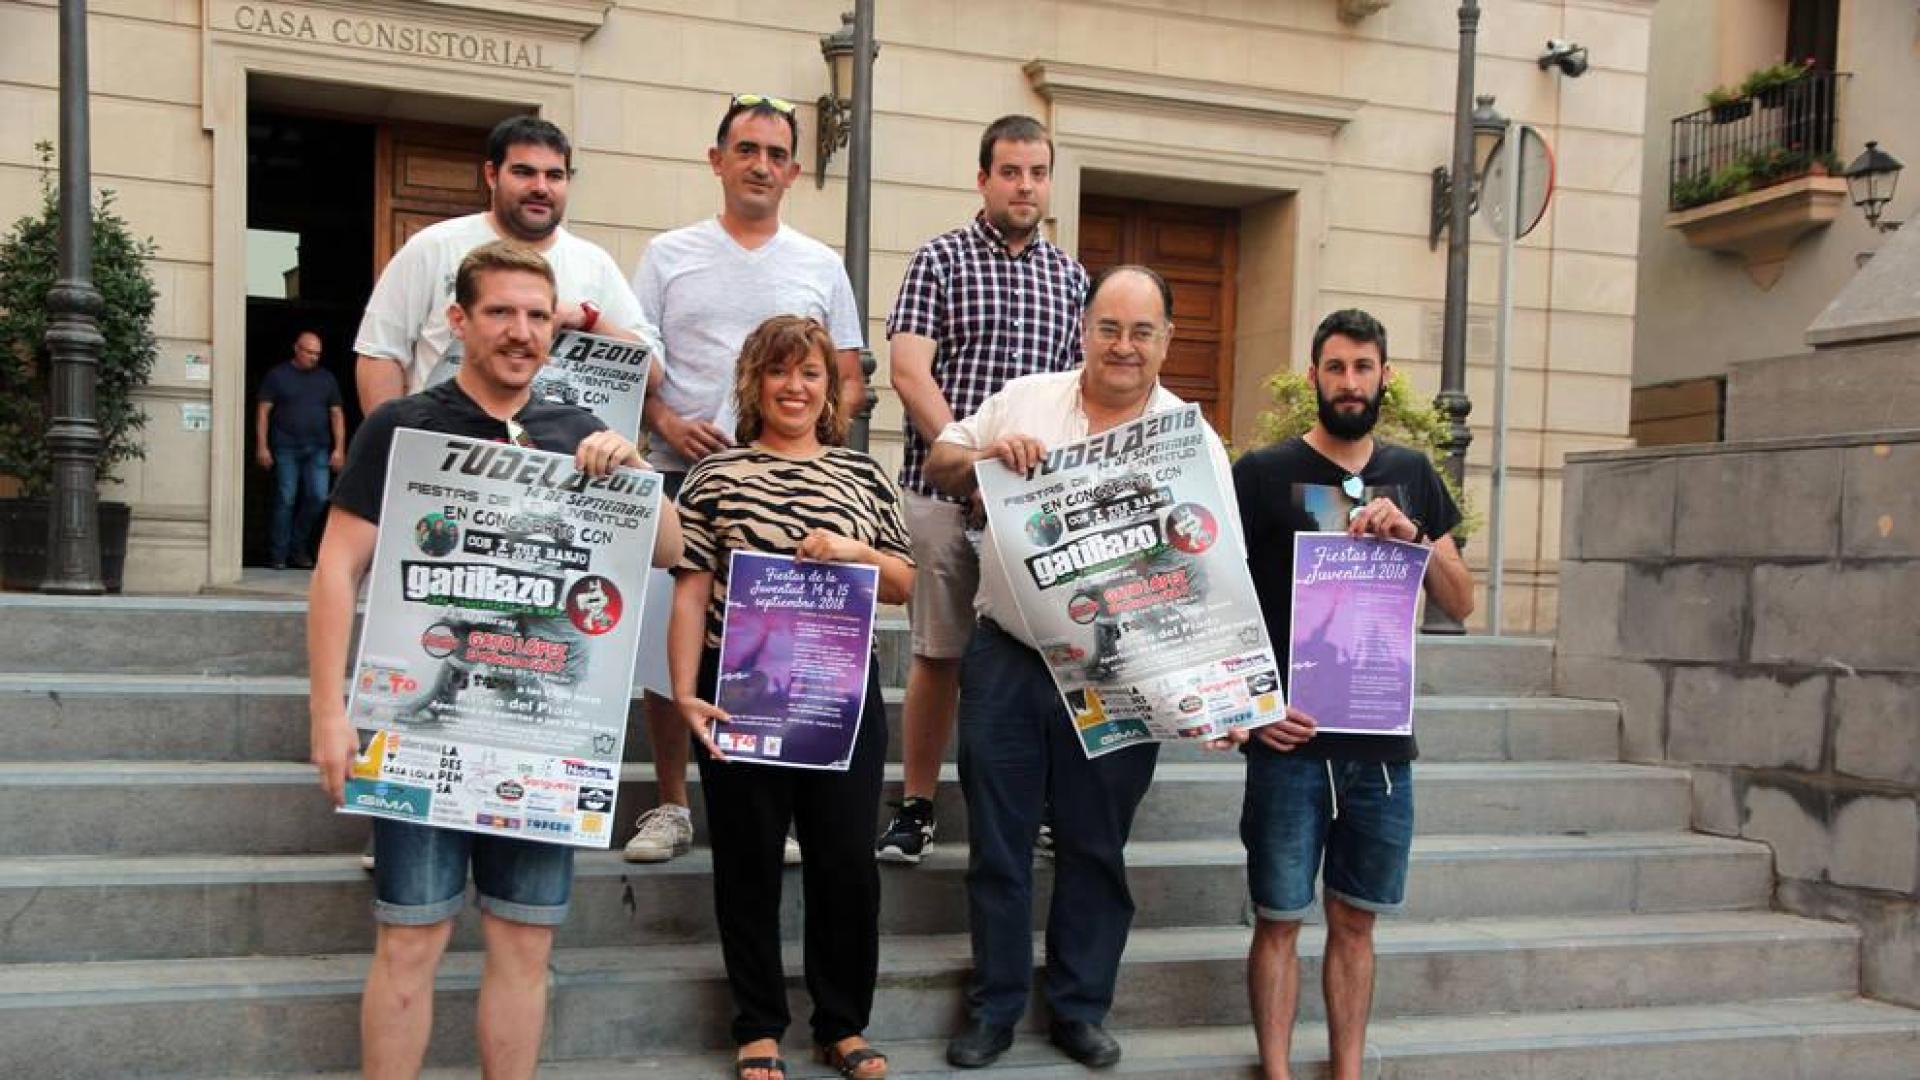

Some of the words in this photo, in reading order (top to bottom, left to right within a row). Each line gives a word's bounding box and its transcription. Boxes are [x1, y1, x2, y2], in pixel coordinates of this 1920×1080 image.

[234, 4, 318, 40] CASA
[332, 17, 553, 71] CONSISTORIAL
[591, 342, 649, 366] 2018
[1145, 409, 1198, 439] 2018
[439, 440, 587, 494] TUDELA
[588, 473, 658, 498] 2018
[406, 480, 480, 504] FIESTAS
[443, 504, 468, 521] EN
[472, 508, 576, 543] CONCERTO
[580, 527, 614, 544] CON
[1313, 545, 1368, 566] Fiestas
[1370, 546, 1388, 562] de
[1390, 546, 1406, 561] la
[766, 567, 805, 582] Fiestas
[808, 569, 823, 583] de
[825, 570, 839, 583] la
[1305, 562, 1376, 585] Juventud
[1378, 563, 1409, 580] 2018
[406, 562, 556, 610] gatillazo
[750, 580, 806, 596] Juventud
[837, 584, 850, 597] 15
[754, 595, 816, 613] septiembre
[817, 596, 846, 610] 2018
